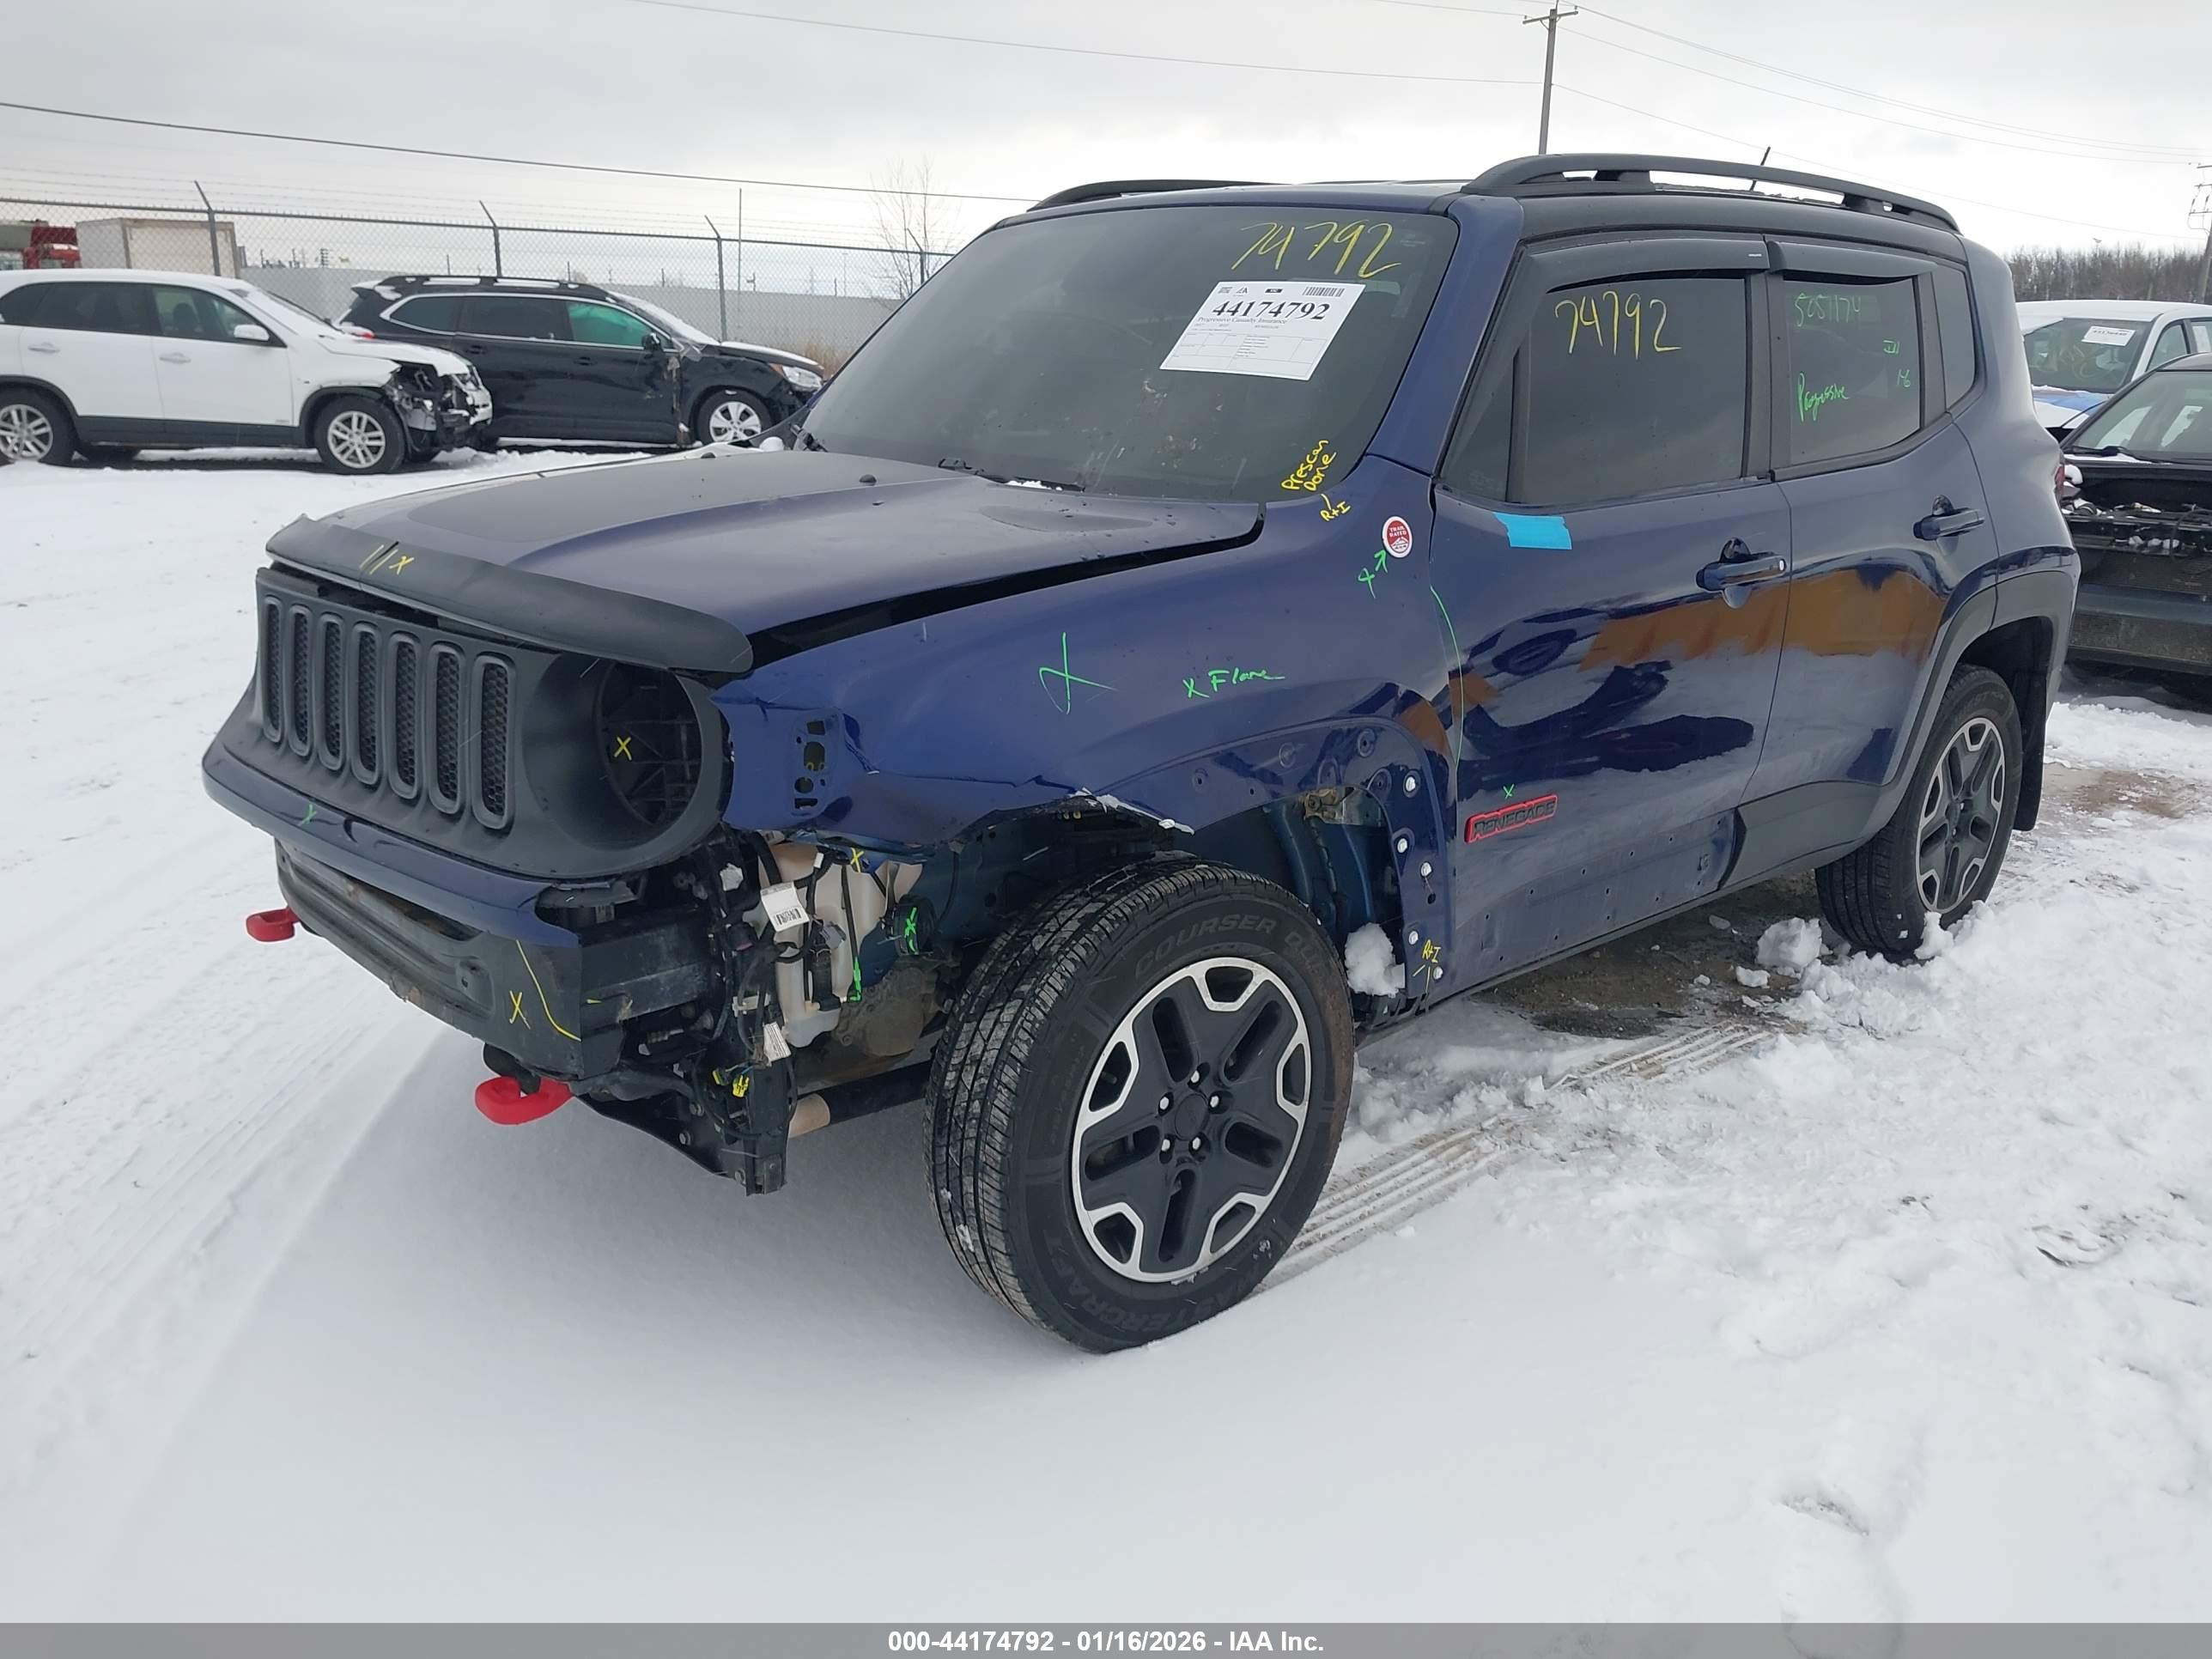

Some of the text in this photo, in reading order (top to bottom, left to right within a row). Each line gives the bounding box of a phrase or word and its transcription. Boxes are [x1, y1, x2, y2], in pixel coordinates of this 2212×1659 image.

[1212, 301, 1330, 320] 44174792
[1555, 290, 1683, 360] 74792
[1304, 452, 1337, 491] Done
[1472, 800, 1556, 839] RENEGADE
[1135, 914, 1277, 979] COURSER
